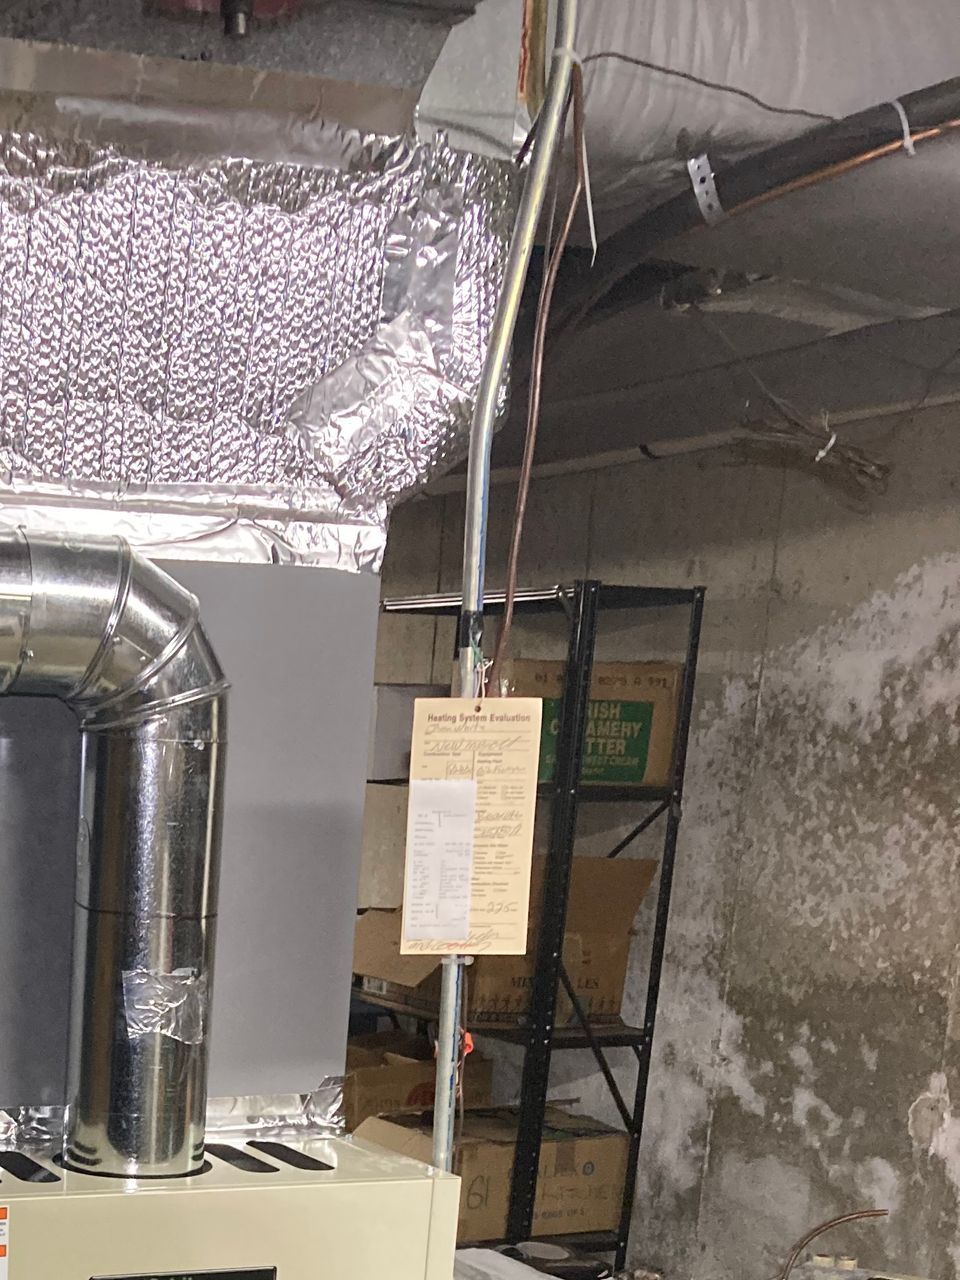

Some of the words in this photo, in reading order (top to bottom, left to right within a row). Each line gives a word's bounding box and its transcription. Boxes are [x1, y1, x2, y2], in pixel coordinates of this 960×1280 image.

[427, 713, 457, 724] Heating
[460, 713, 487, 723] System
[490, 713, 531, 722] Evaluation
[585, 738, 626, 755] TTER
